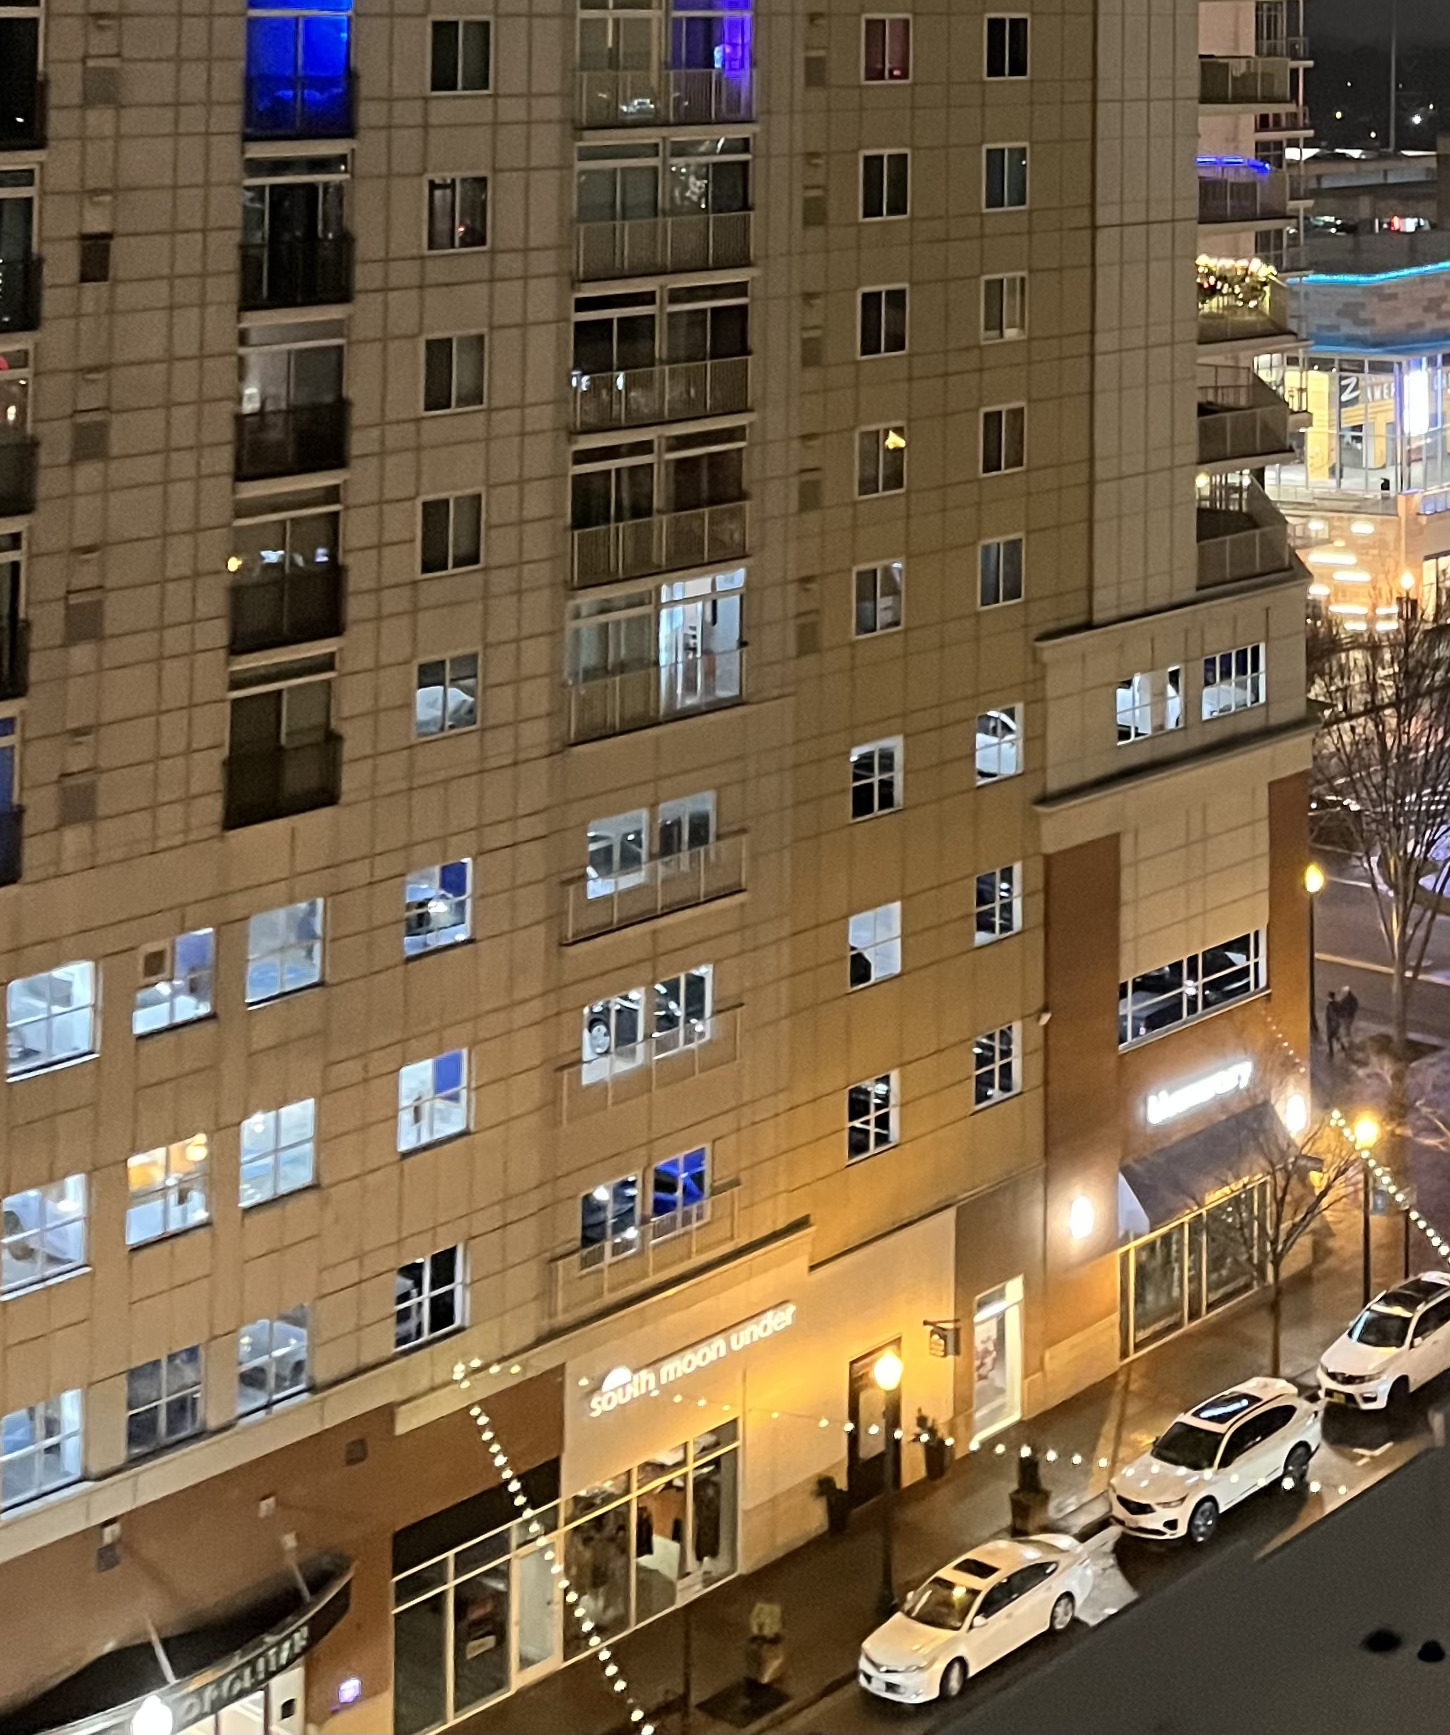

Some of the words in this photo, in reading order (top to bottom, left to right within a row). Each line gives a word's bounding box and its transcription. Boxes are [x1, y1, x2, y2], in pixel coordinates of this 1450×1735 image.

[589, 1368, 656, 1418] south
[659, 1336, 727, 1385] moon
[730, 1302, 797, 1352] under
